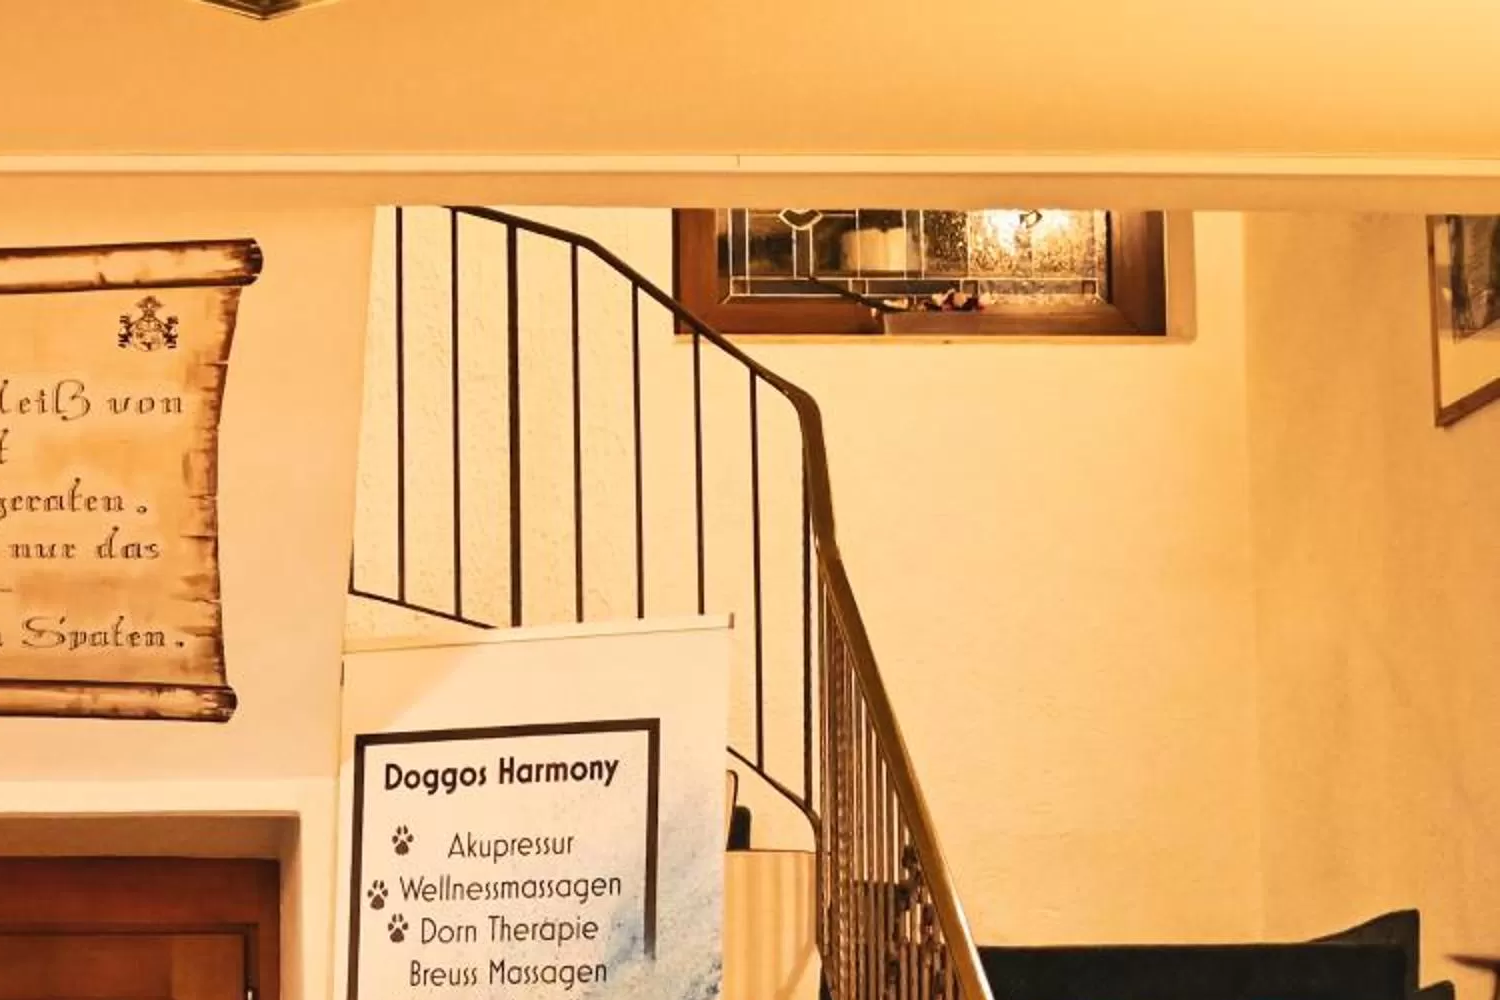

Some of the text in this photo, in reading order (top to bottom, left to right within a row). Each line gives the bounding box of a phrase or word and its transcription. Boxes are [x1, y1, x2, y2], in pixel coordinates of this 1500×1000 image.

[106, 395, 184, 415] von
[8, 542, 76, 559] nur
[95, 525, 160, 559] das
[21, 615, 185, 650] Spaten.
[384, 756, 620, 795] Doggos Harmony
[447, 831, 575, 864] Akupressur
[399, 873, 622, 904] Wellnessmassagen
[421, 915, 599, 946] Dorn Therapie
[409, 959, 607, 990] Breuss Massagen
